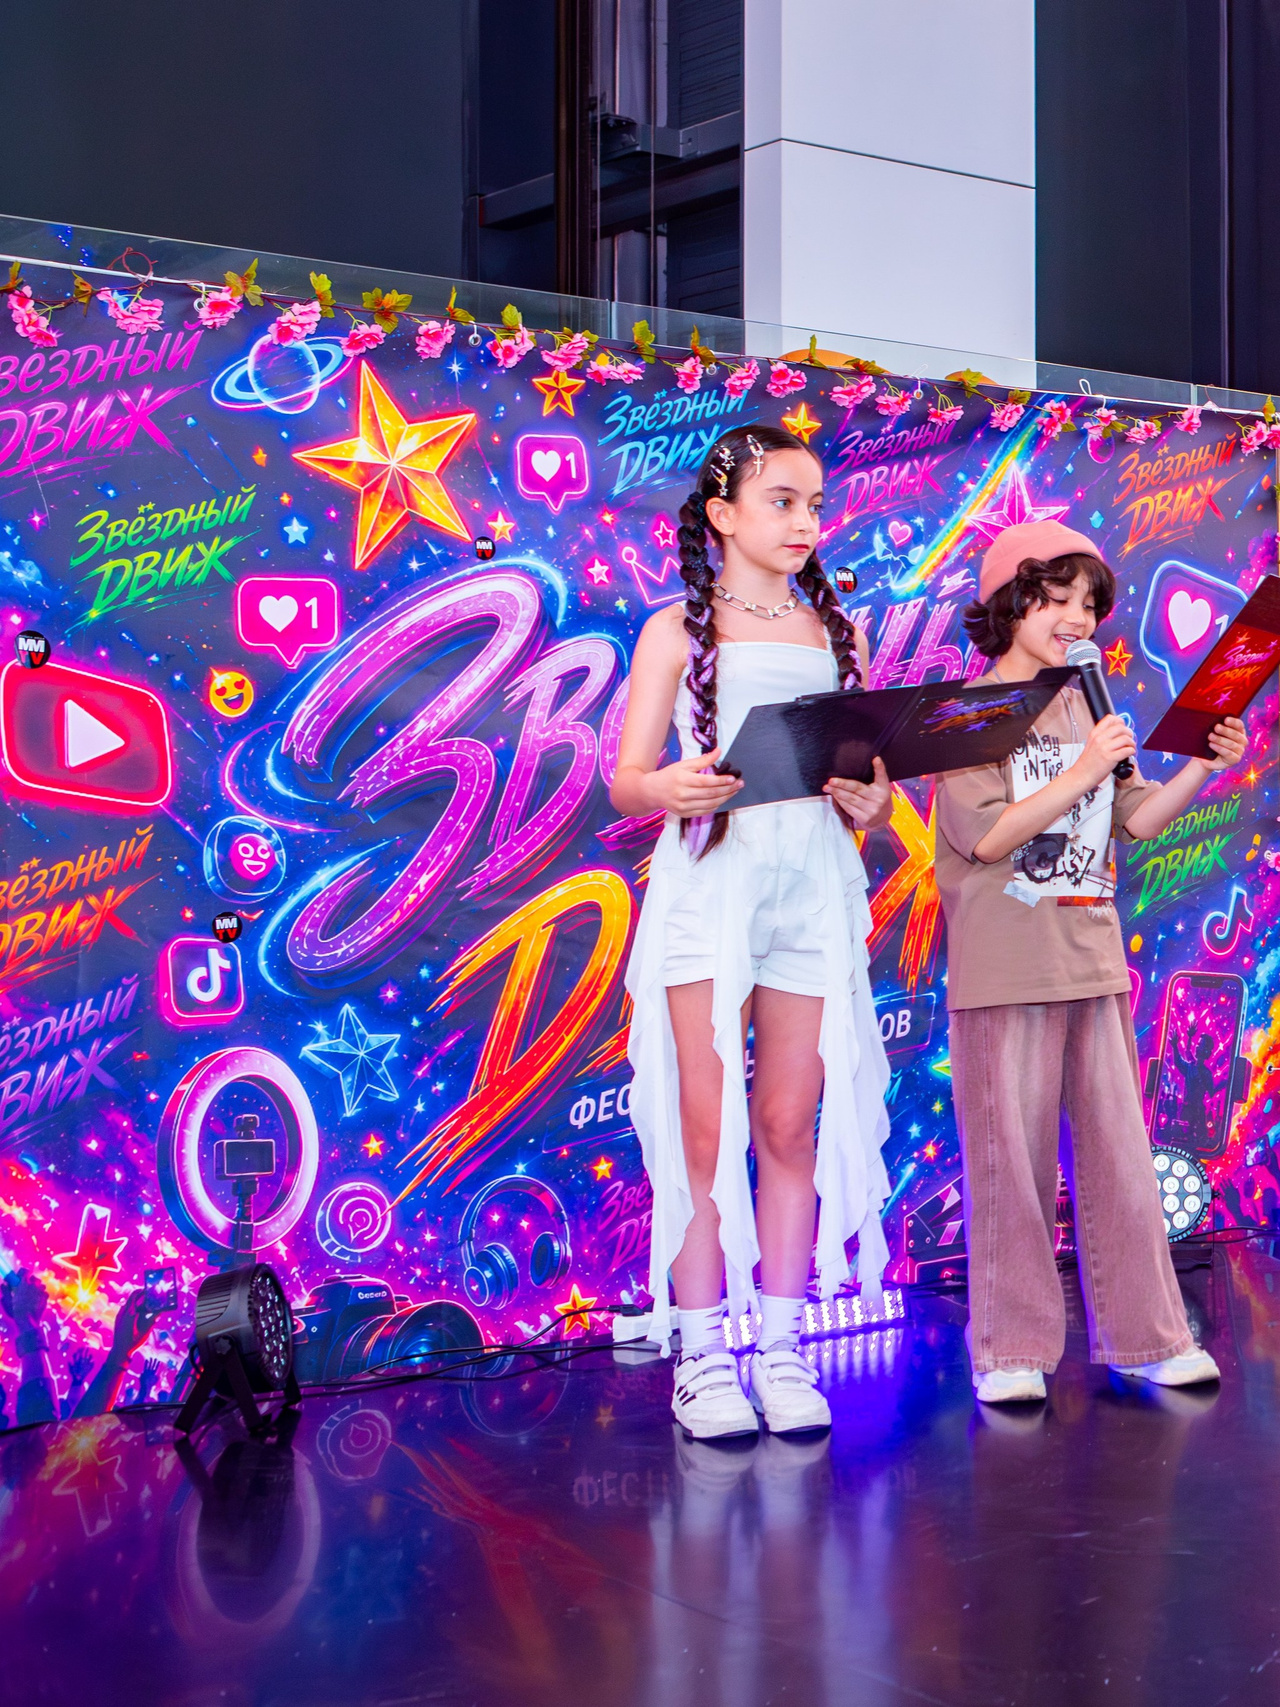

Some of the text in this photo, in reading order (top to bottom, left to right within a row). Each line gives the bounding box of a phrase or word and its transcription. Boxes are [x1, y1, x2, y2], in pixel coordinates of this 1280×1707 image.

[565, 452, 577, 479] 1
[833, 450, 955, 518] ДВИЖ
[1112, 432, 1237, 507] Звёздный
[70, 484, 257, 568] Звёздный
[1118, 474, 1236, 547] ДВИЖ
[76, 532, 255, 612] ДВИЖ
[18, 637, 46, 653] MM
[304, 597, 319, 629] 1
[1131, 834, 1238, 906] ДВИЖ
[0, 878, 152, 970] ВИЖ
[215, 917, 238, 930] MM
[216, 928, 238, 940] TV
[0, 1034, 132, 1134] ВИЖ
